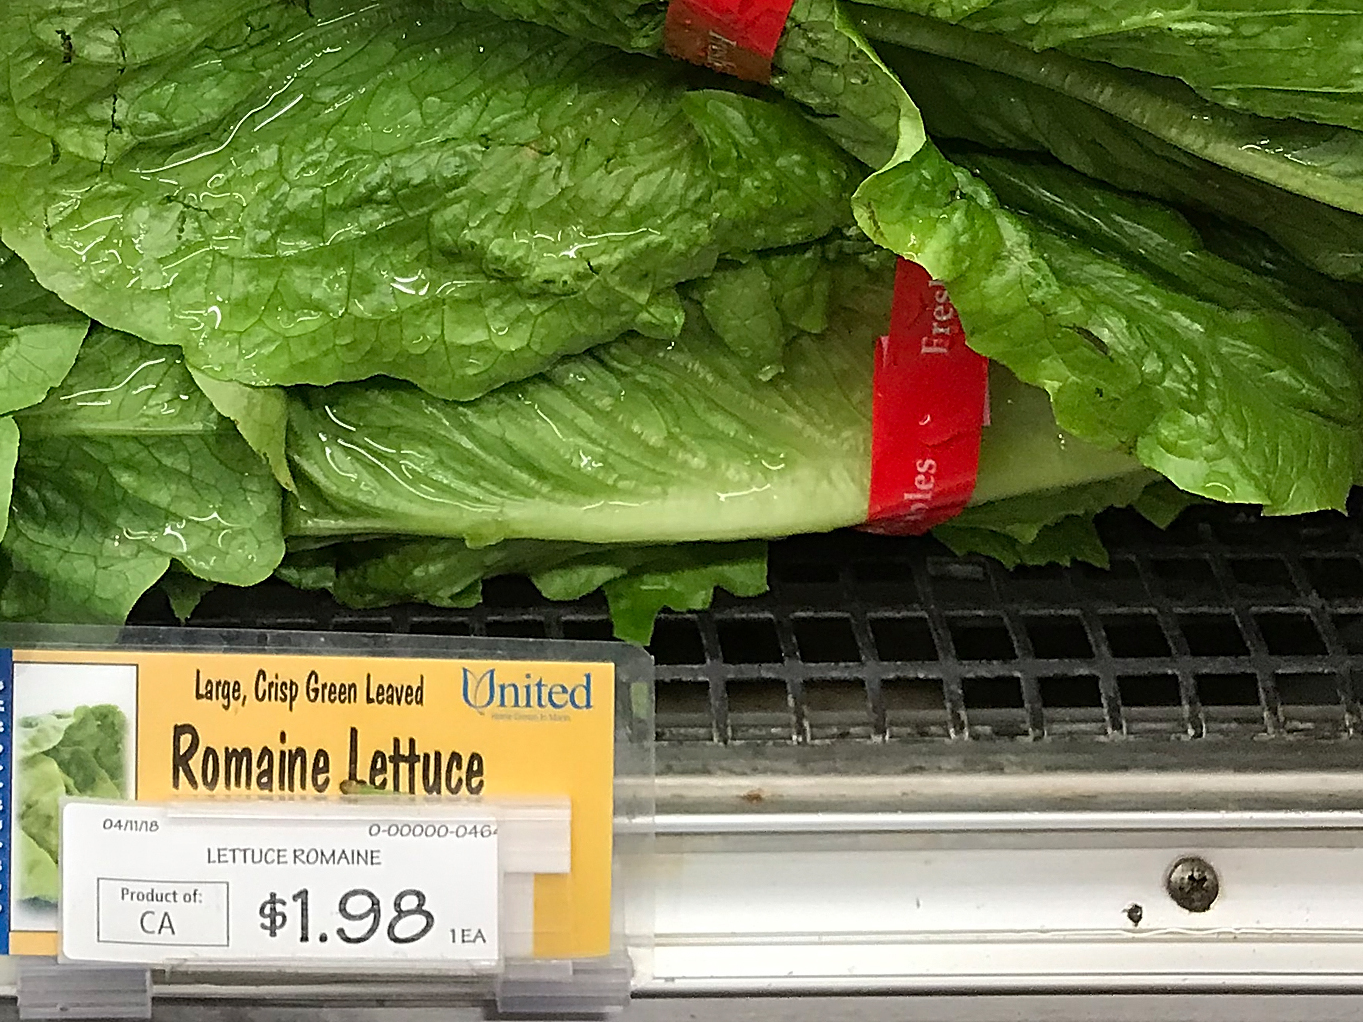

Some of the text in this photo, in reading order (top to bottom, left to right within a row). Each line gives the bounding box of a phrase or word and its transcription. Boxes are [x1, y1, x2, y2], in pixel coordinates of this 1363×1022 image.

[195, 669, 424, 712] Large, Crisp Green Leaved
[462, 667, 593, 715] United
[172, 724, 485, 795] Romaine Lettuce
[102, 818, 160, 832] 04/11/18
[207, 847, 382, 866] LETTUCE ROMAINE
[121, 887, 203, 904] Product of:
[140, 910, 176, 935] CA
[258, 888, 435, 944] $1.98
